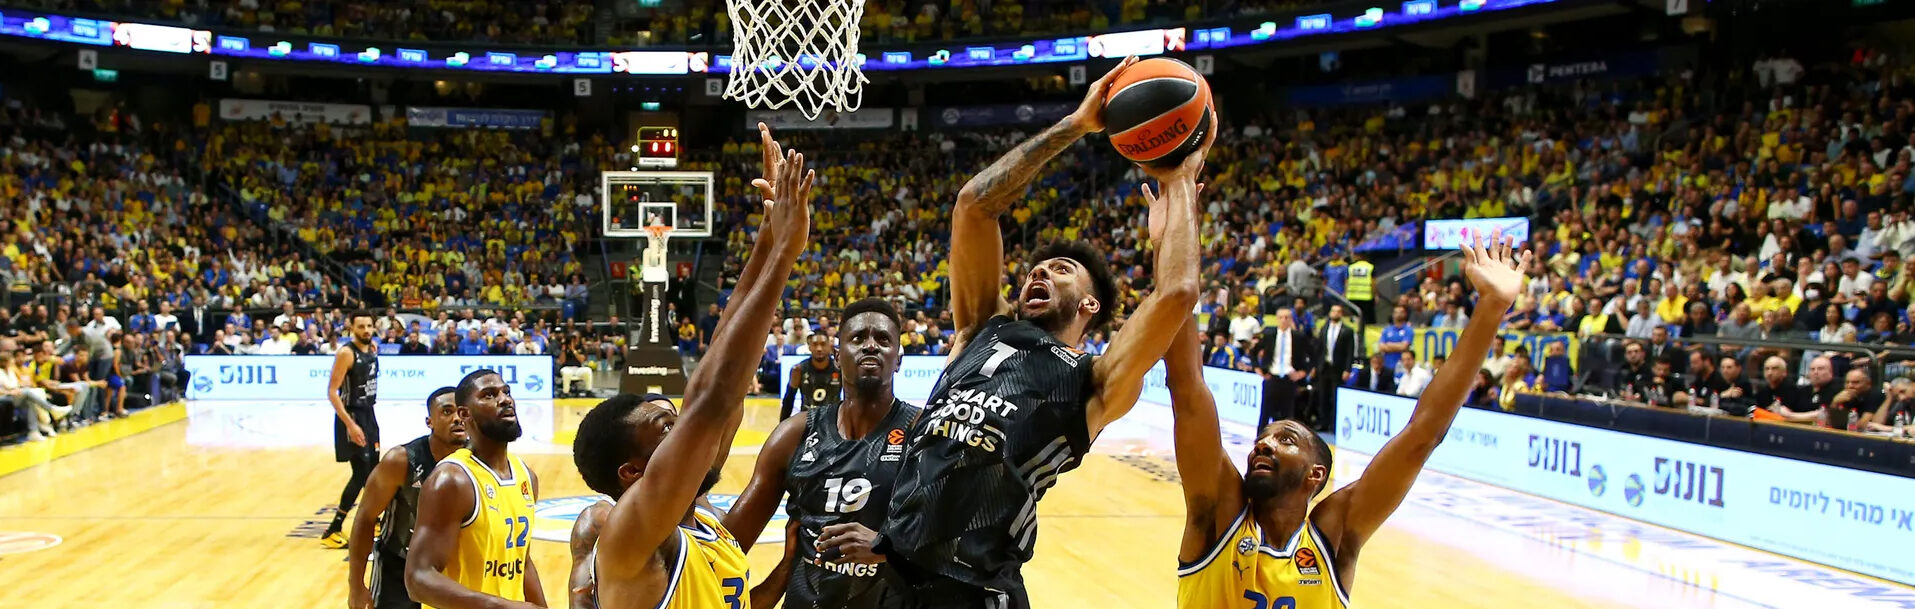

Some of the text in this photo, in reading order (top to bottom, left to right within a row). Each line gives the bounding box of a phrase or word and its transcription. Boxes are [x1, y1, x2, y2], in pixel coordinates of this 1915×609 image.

[1549, 61, 1608, 77] PENTERA
[1118, 117, 1188, 156] SPALDING
[813, 388, 827, 401] 0
[946, 389, 1018, 418] SMART
[823, 477, 874, 513] 19
[1769, 485, 1830, 515] ליזמים
[1835, 497, 1884, 525] מהיר
[505, 516, 529, 549] 22
